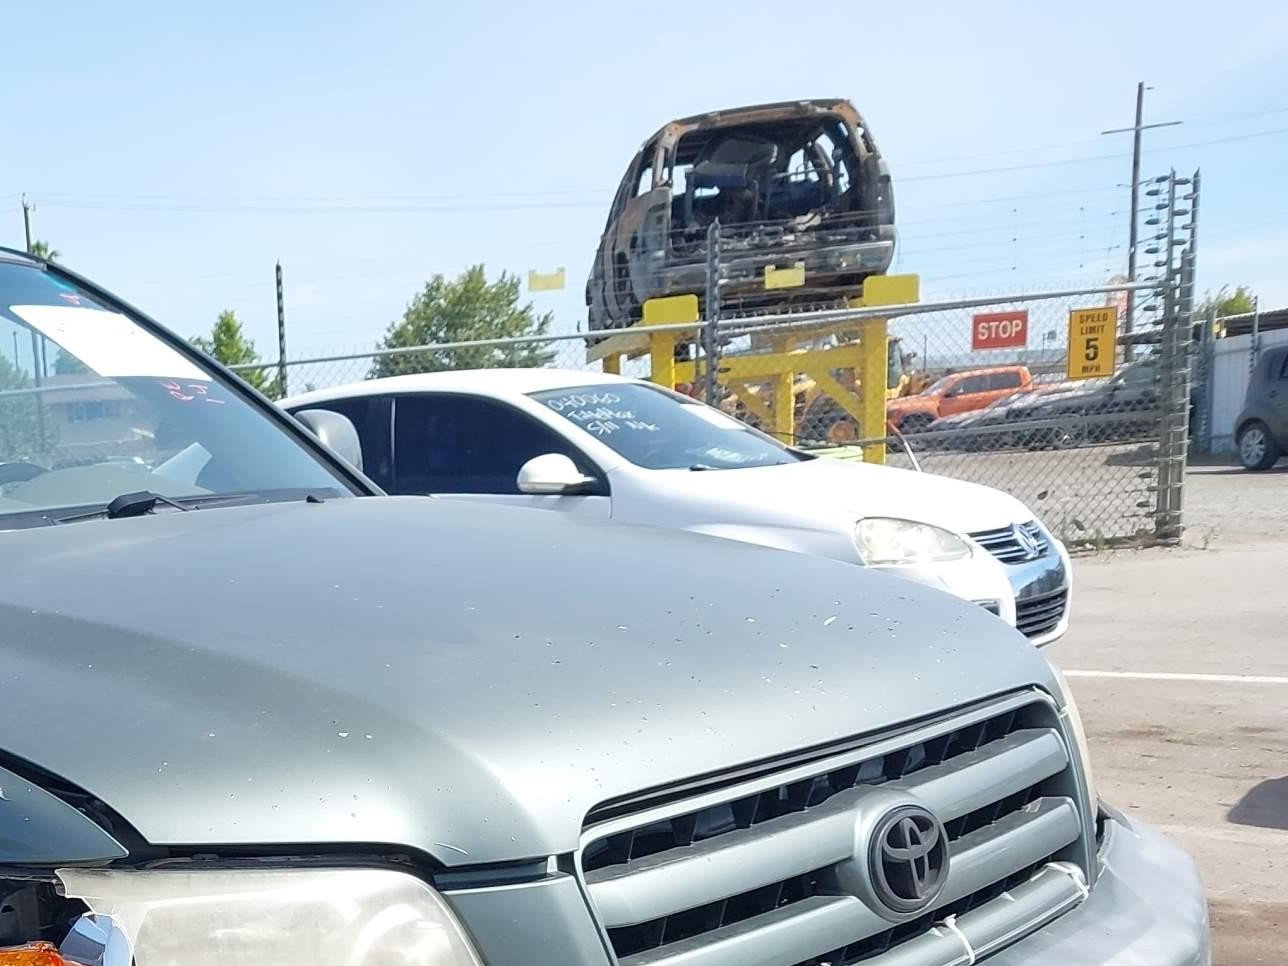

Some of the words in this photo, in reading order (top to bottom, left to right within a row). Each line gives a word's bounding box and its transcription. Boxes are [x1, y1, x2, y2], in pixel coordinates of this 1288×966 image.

[1080, 312, 1109, 324] SPEED
[977, 319, 1023, 340] STOP
[1080, 324, 1105, 336] LIMIT
[1085, 337, 1099, 361] 5
